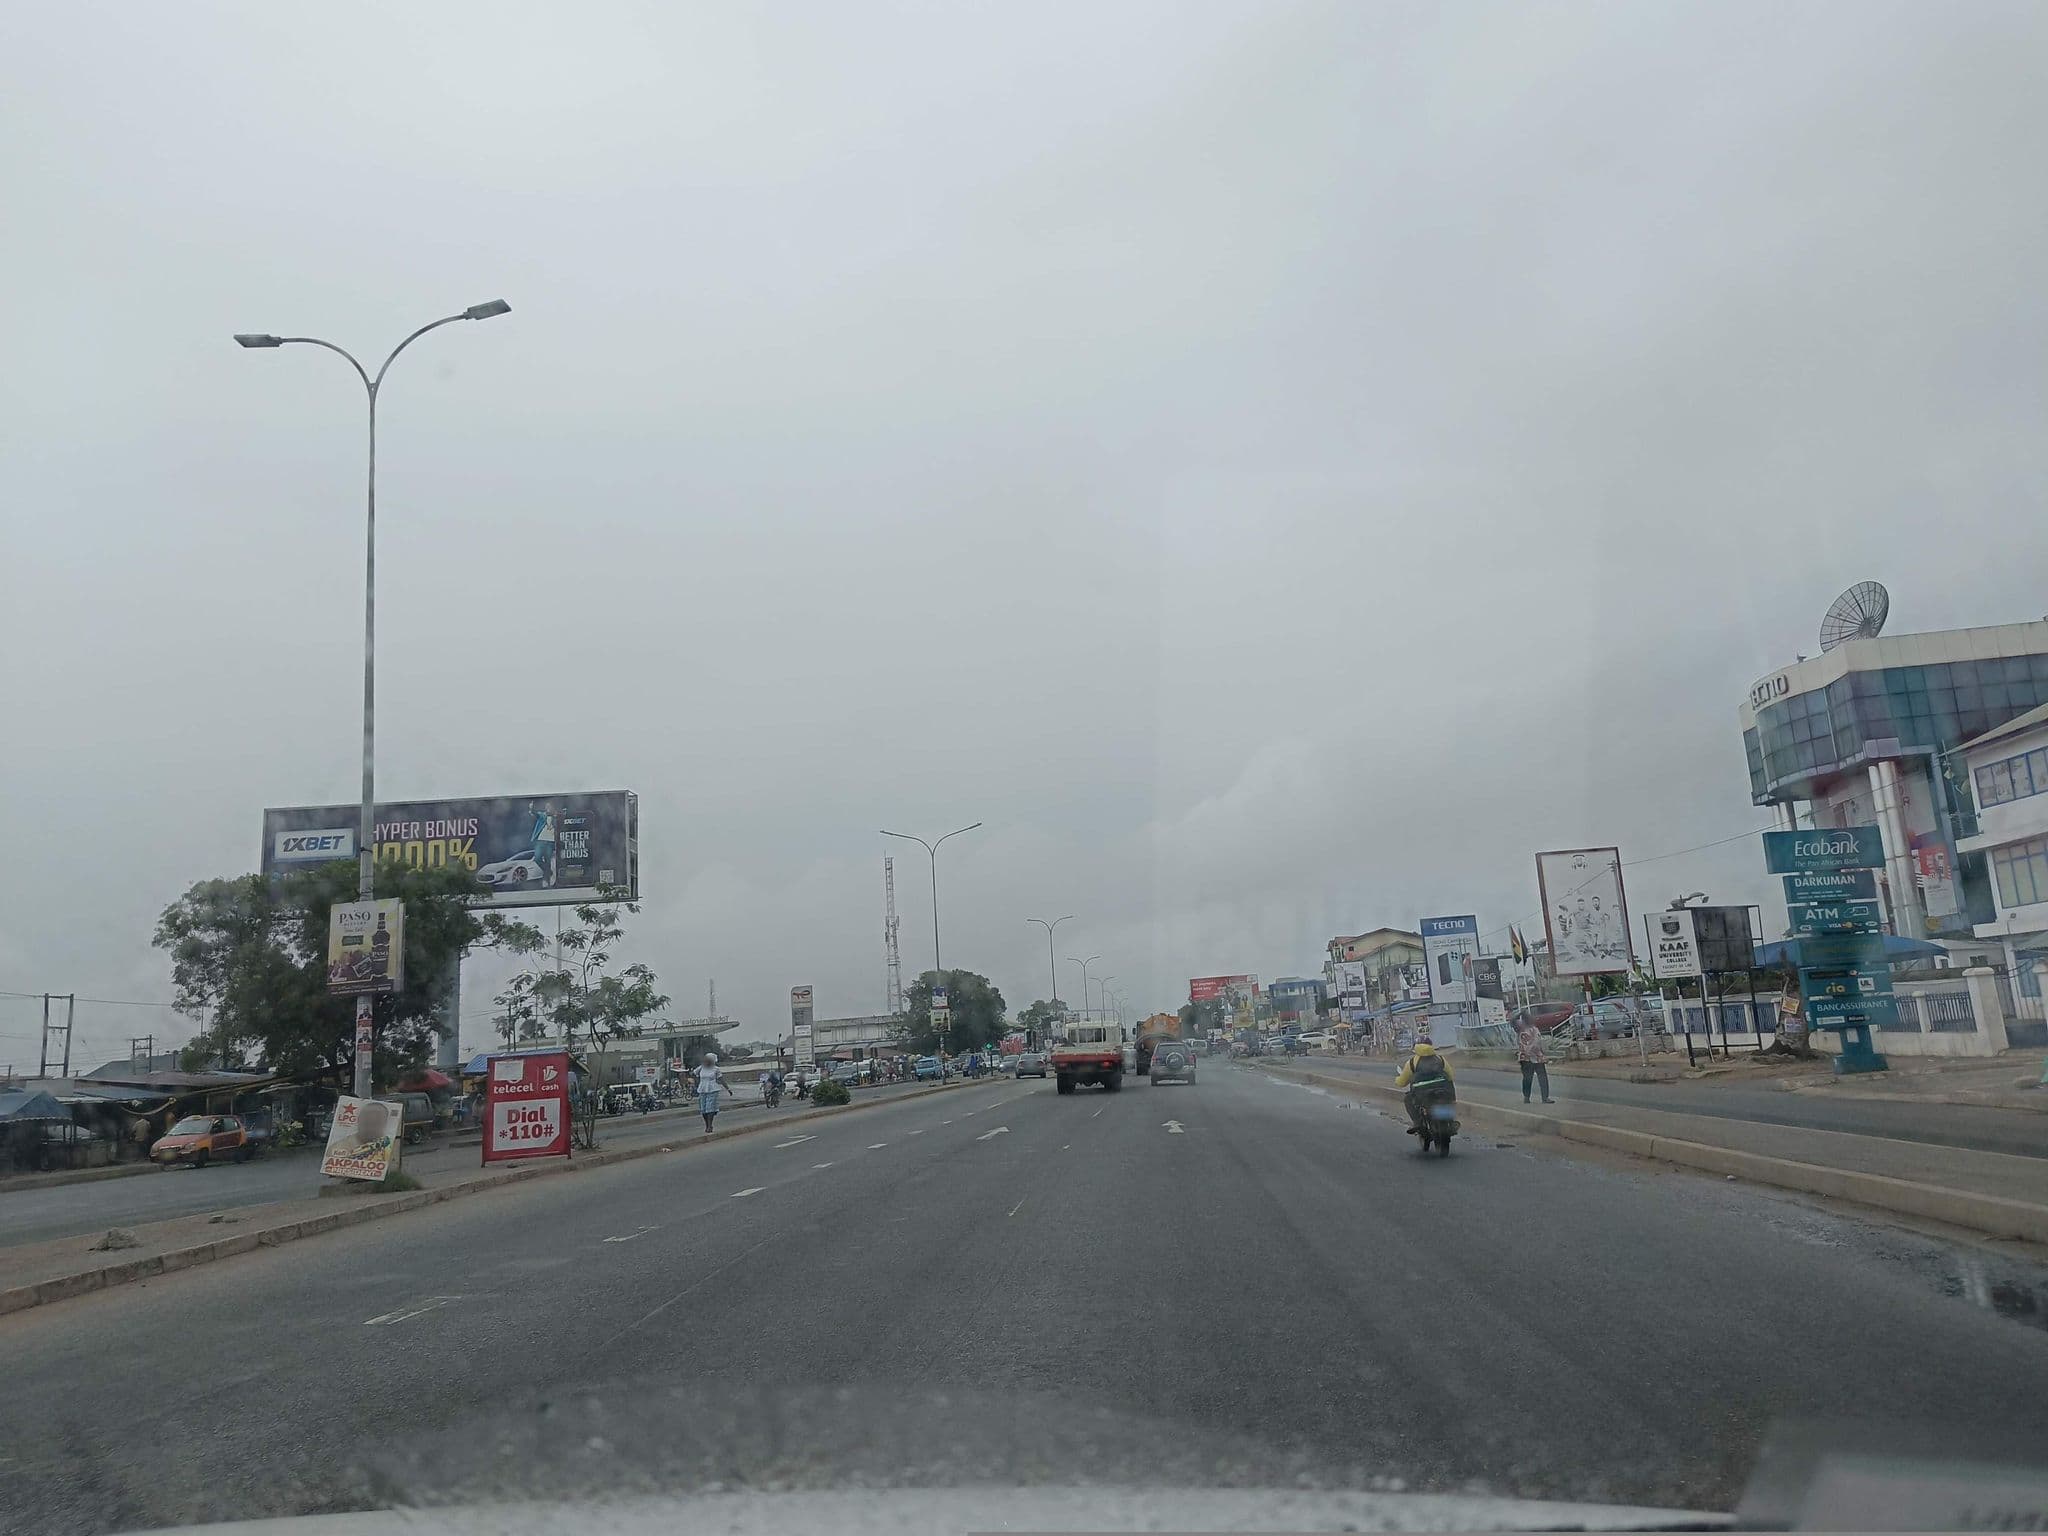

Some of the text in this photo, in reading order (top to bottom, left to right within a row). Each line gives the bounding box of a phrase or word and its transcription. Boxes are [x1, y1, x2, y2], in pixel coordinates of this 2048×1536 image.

[373, 818, 479, 841] HYPER BONUS
[560, 830, 590, 841] BETTER
[282, 835, 345, 852] 1XBET
[564, 840, 585, 850] THAN
[1795, 838, 1859, 857] Ecobank
[561, 848, 589, 859] BONUS
[1794, 875, 1856, 888] DARKUMAN
[339, 911, 371, 923] PASO
[1805, 908, 1839, 920] ATM
[1432, 919, 1465, 930] TECNO
[1659, 941, 1689, 952] KAAF
[1658, 951, 1692, 959] UNIVERSITY
[1478, 972, 1497, 981] CBG
[1817, 1000, 1889, 1011] BANCASSURANCE
[493, 1083, 534, 1094] telecel
[338, 1114, 357, 1122] LPG
[507, 1106, 547, 1124] Dial
[325, 1157, 385, 1170] AKPALOO
